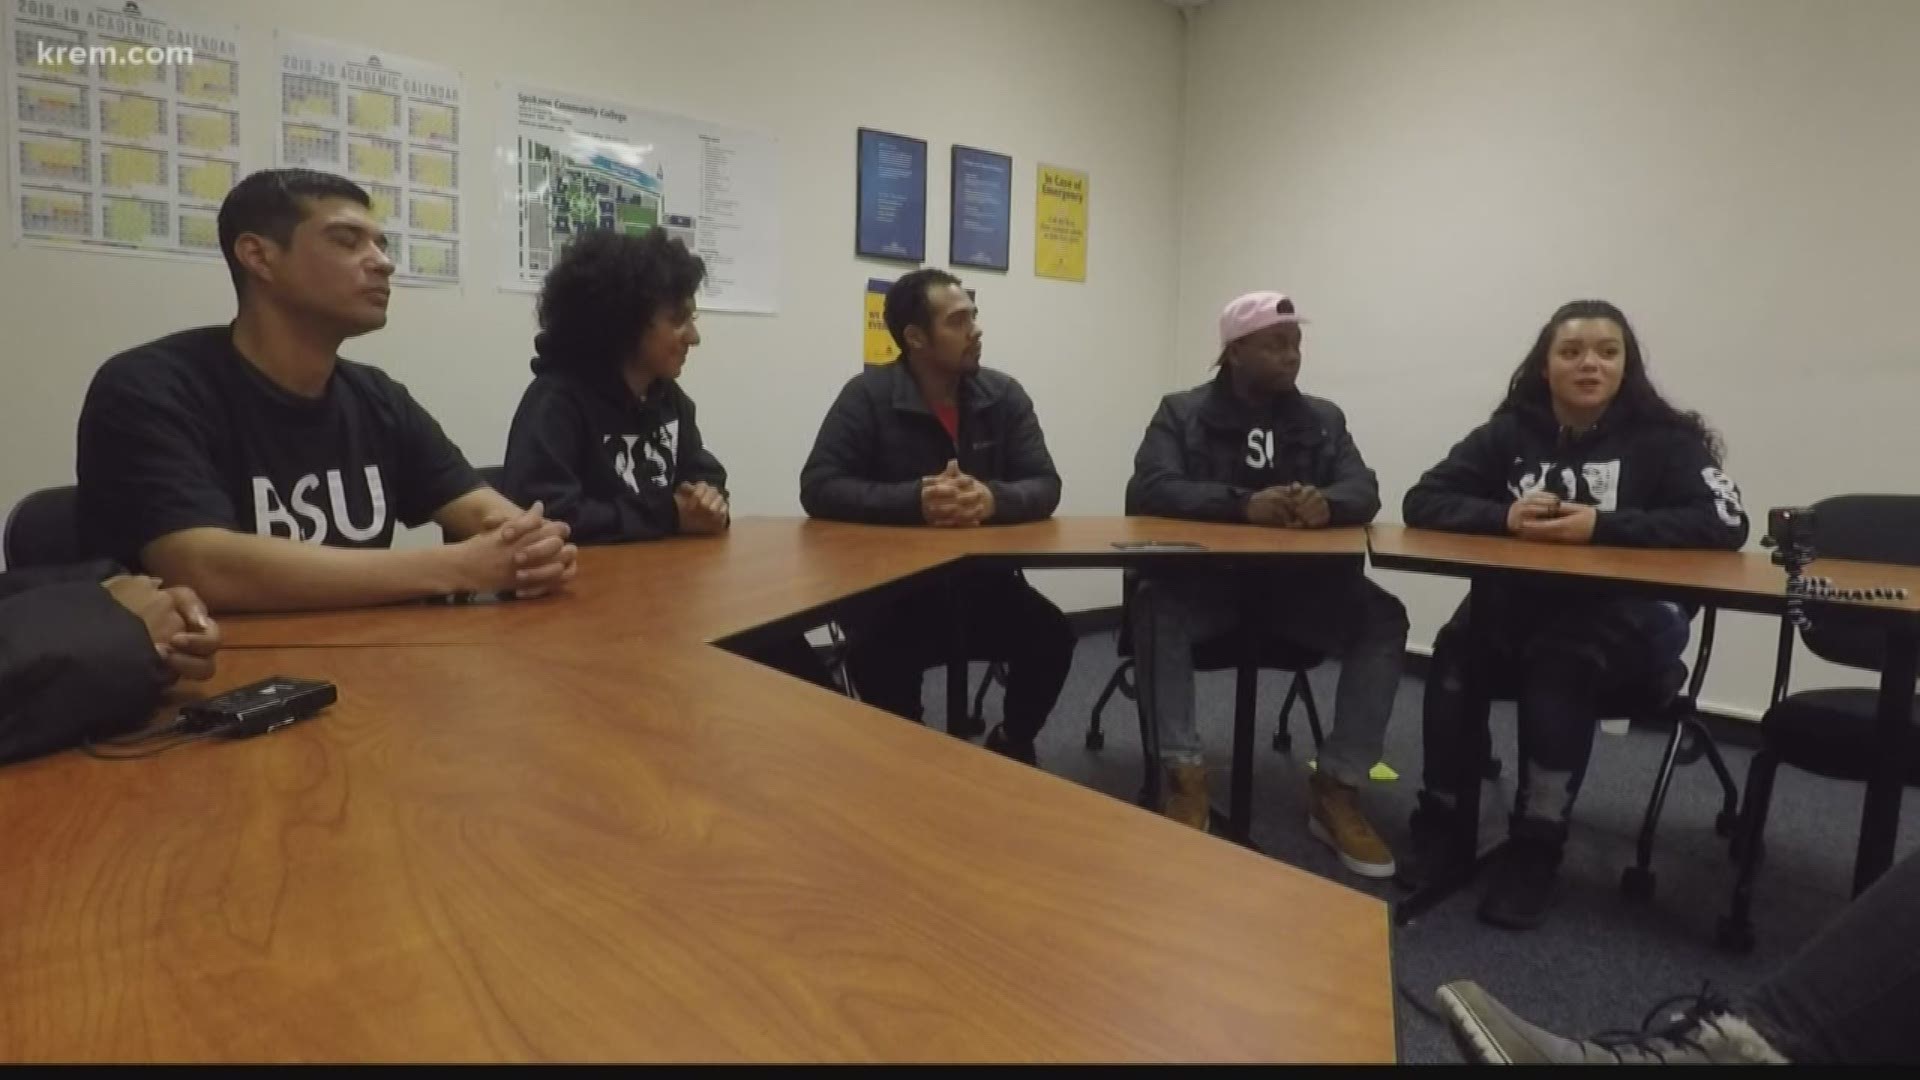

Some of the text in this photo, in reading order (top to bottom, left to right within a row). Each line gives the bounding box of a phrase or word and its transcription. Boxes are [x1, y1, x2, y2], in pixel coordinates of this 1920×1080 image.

[87, 11, 161, 41] ACADEMIC
[167, 29, 238, 55] CALENDAR
[341, 65, 400, 91] ACADEMIC
[403, 78, 460, 102] CALENDAR
[518, 92, 552, 108] Spokane
[555, 98, 598, 119] Community
[600, 108, 628, 124] College
[1042, 183, 1084, 205] Emergency
[1044, 171, 1083, 191] In Case of
